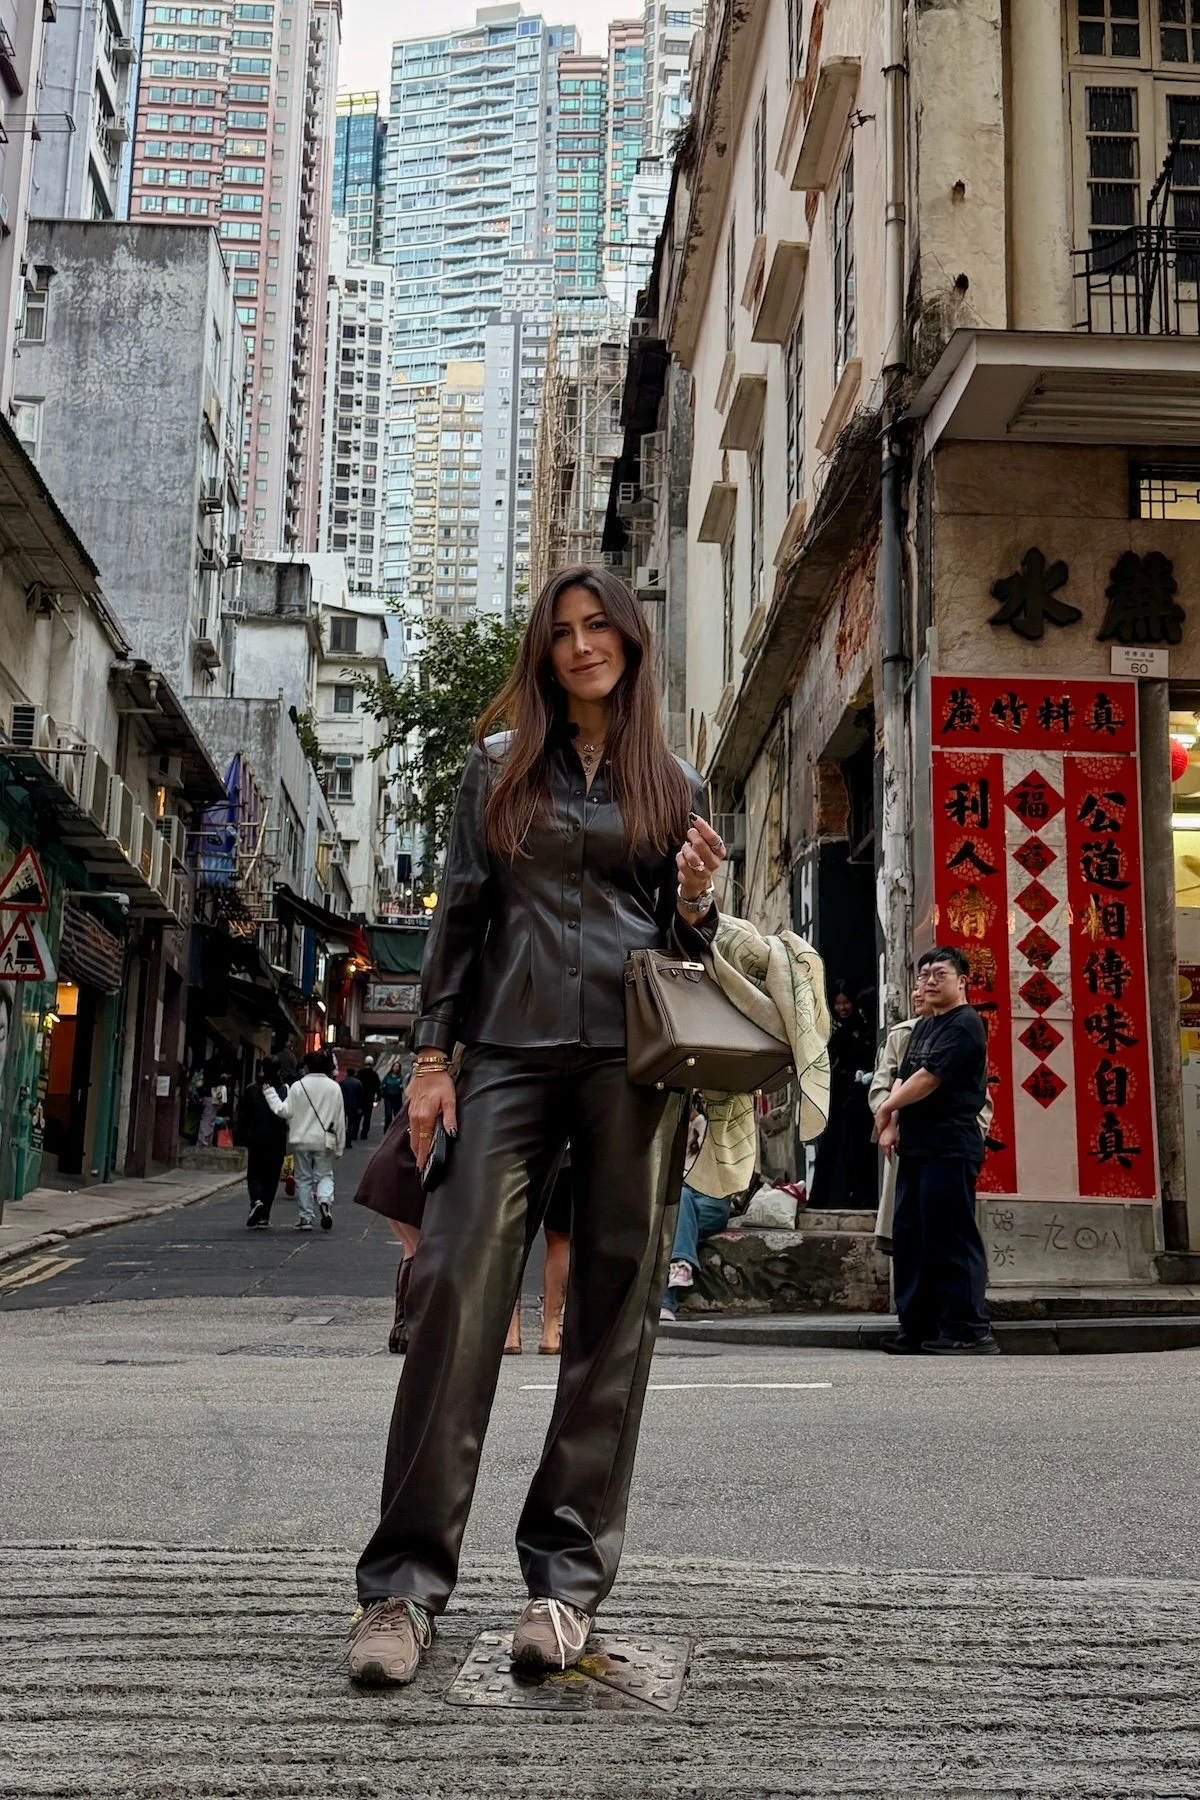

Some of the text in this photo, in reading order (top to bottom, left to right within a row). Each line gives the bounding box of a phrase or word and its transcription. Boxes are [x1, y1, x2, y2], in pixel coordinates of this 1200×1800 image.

[1131, 663, 1148, 674] 60
[1014, 782, 1048, 818] 福
[15, 874, 34, 892] 1:5
[1076, 791, 1141, 1170] 公道相傳味自真
[1029, 1069, 1057, 1100] 福
